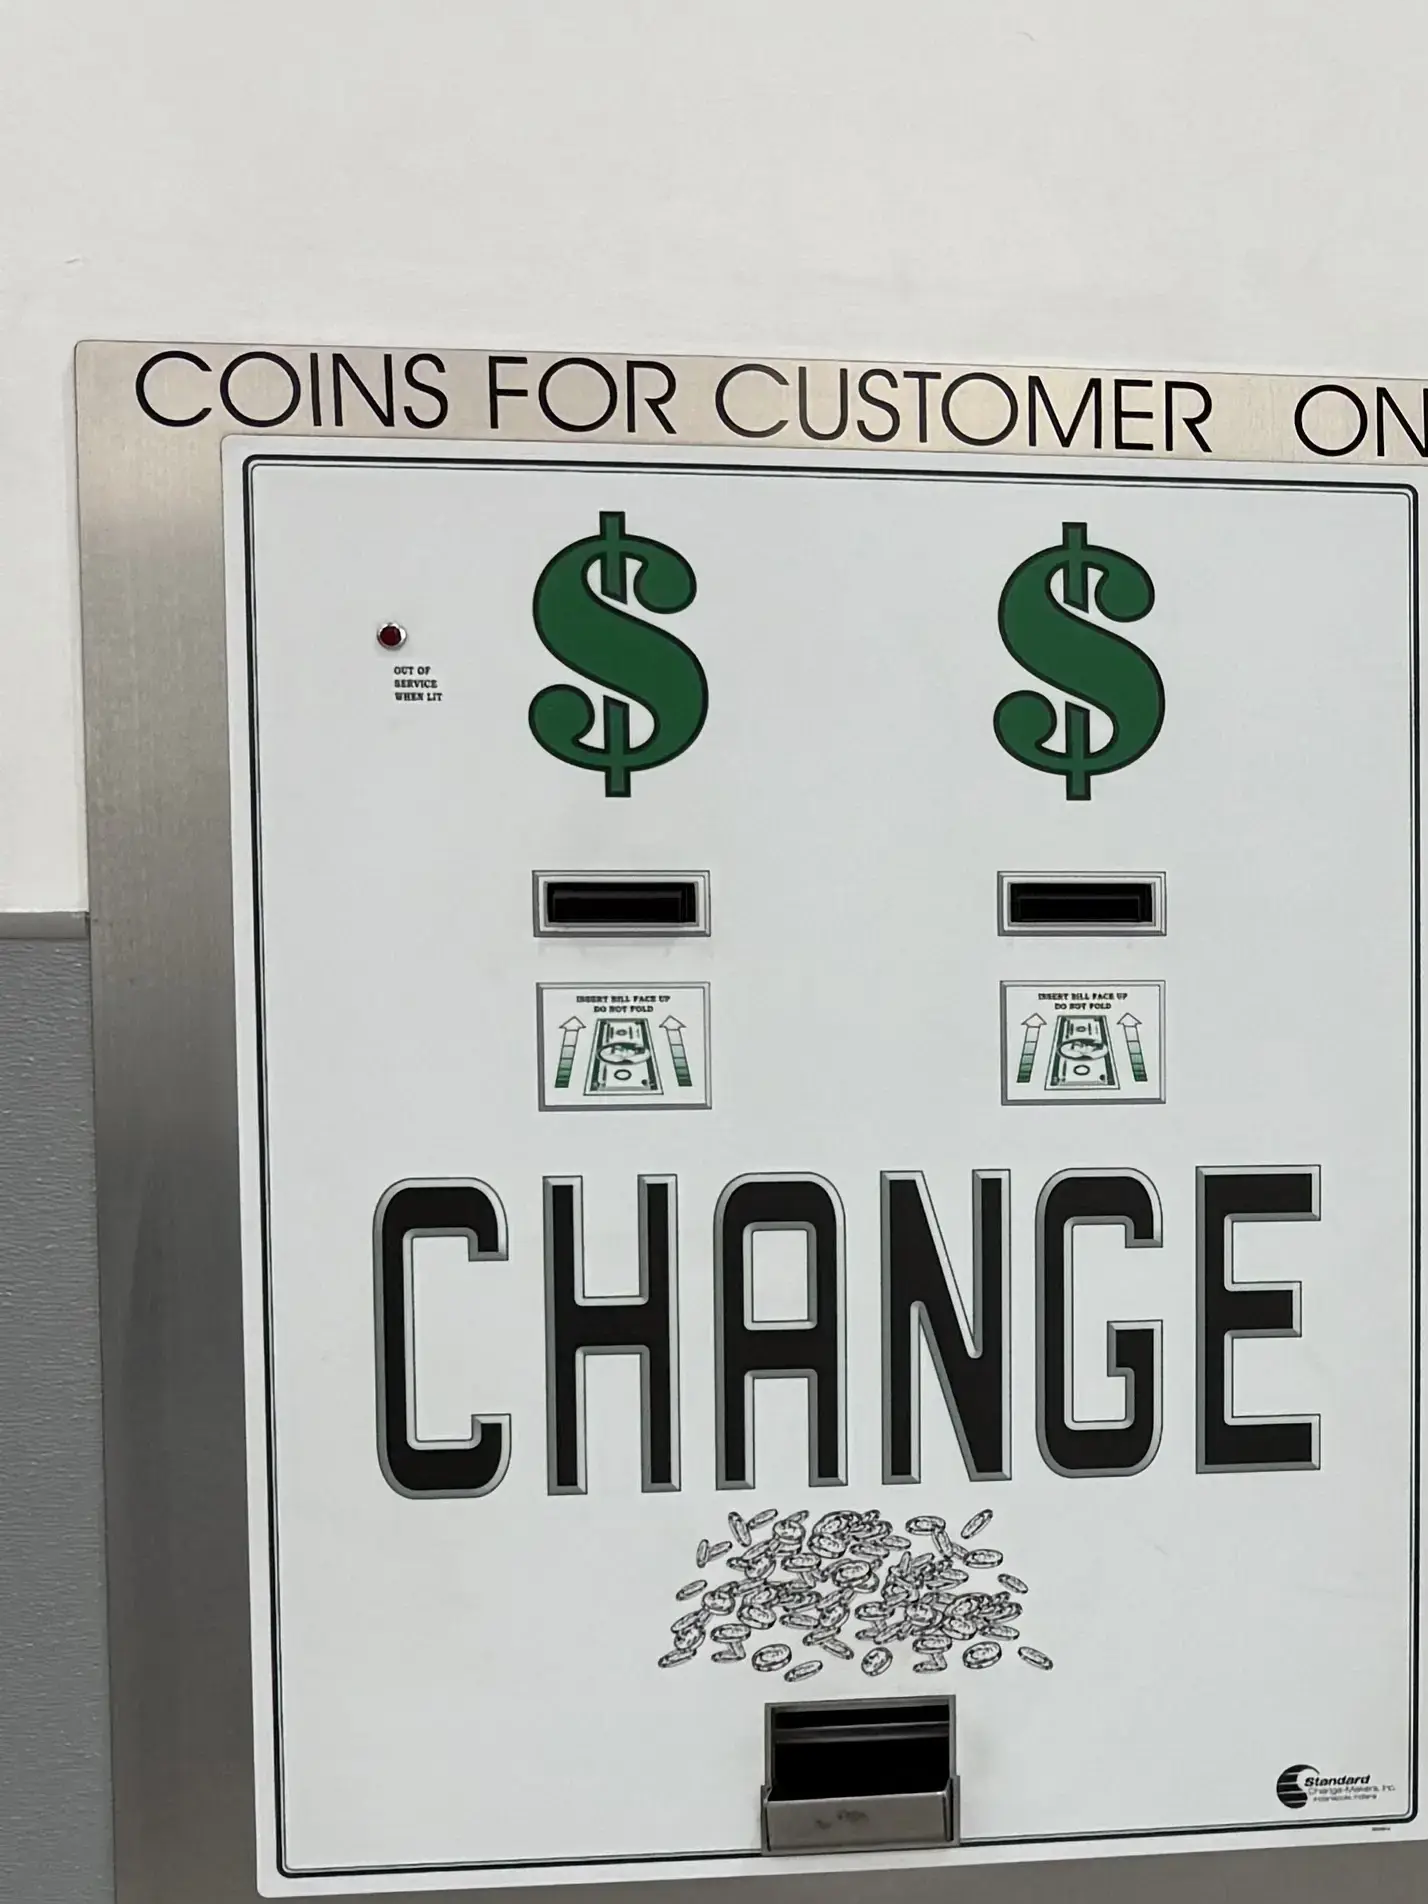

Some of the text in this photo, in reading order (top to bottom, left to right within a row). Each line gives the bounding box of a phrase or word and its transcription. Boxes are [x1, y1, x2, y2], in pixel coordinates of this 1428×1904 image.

[135, 350, 449, 429] COINS
[488, 355, 677, 435] FOR
[715, 363, 1213, 453] CUSTOMER
[393, 666, 431, 675] OUT OF
[527, 510, 1166, 802] $ $
[371, 1163, 1322, 1500] CHANGE
[1304, 1774, 1371, 1787] Standard
